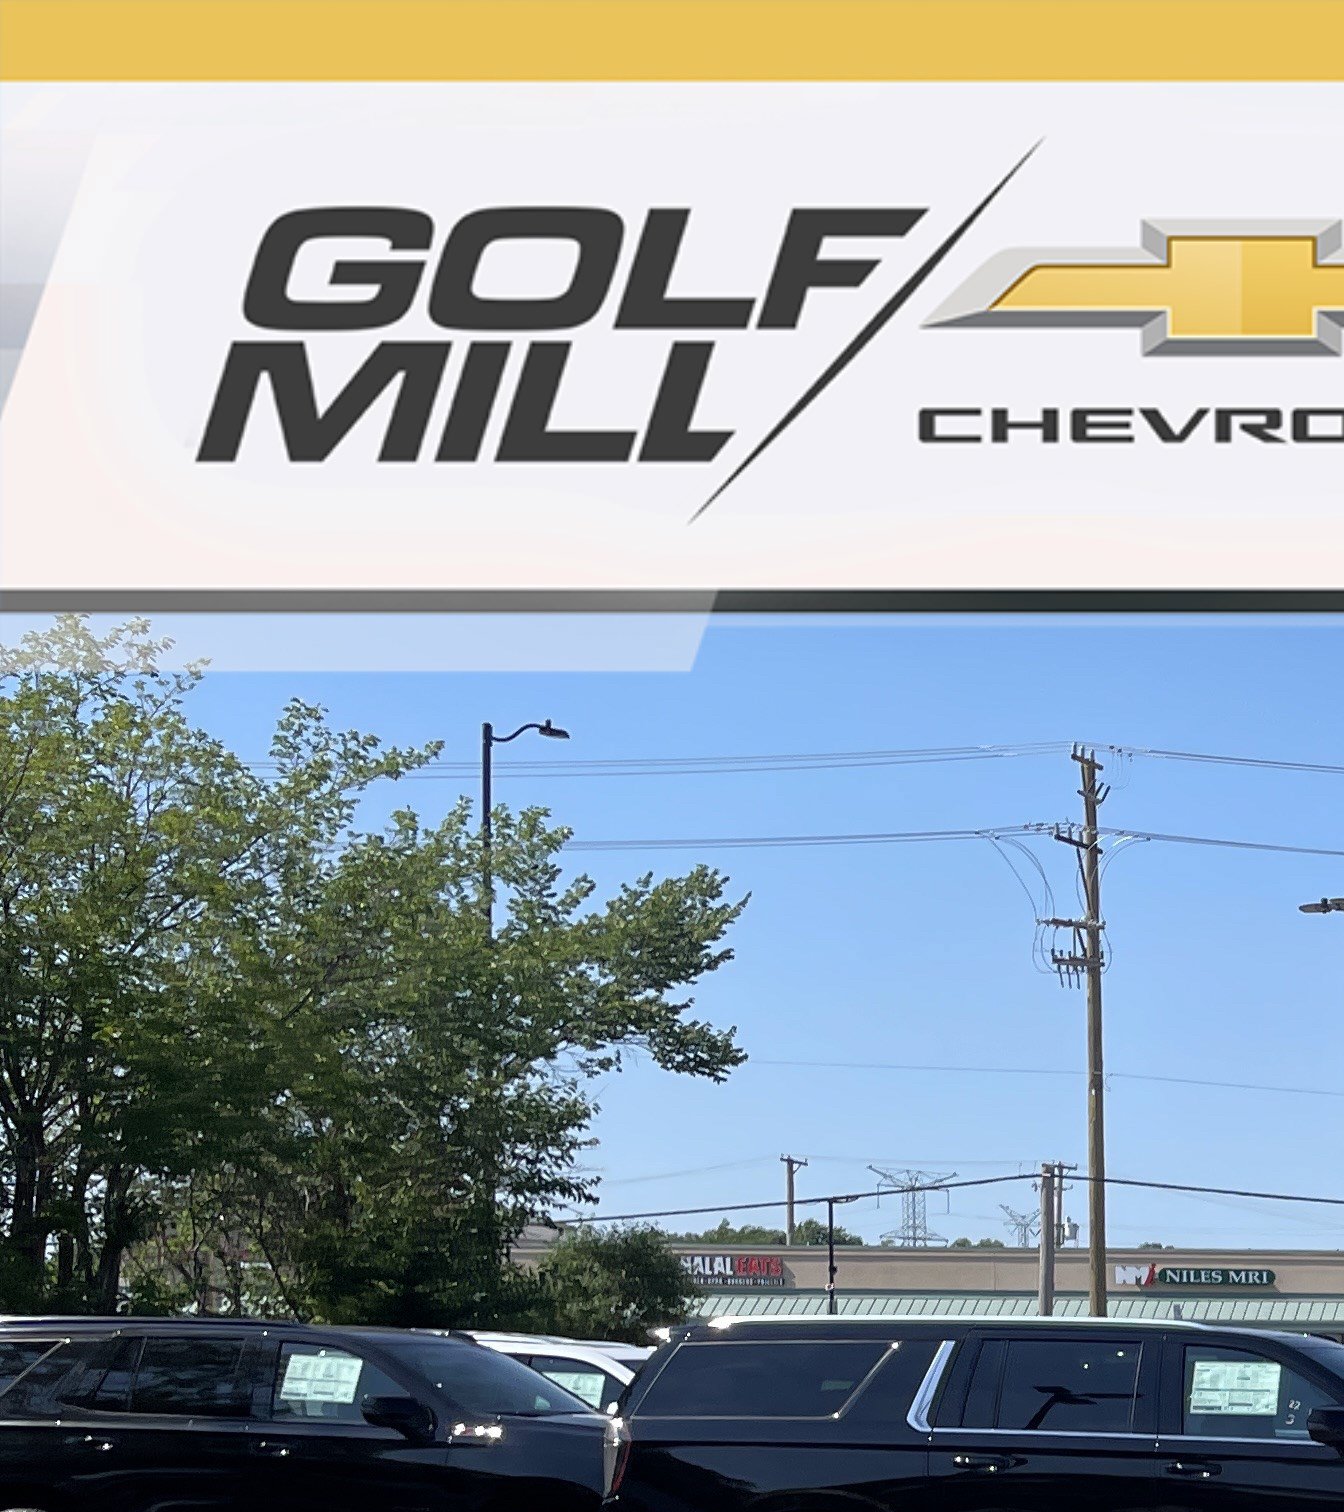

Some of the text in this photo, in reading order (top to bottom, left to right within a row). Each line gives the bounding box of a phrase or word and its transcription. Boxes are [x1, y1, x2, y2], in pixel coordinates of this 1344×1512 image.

[680, 1256, 783, 1277] HALAL EATS
[1165, 1269, 1269, 1285] NILES MRI
